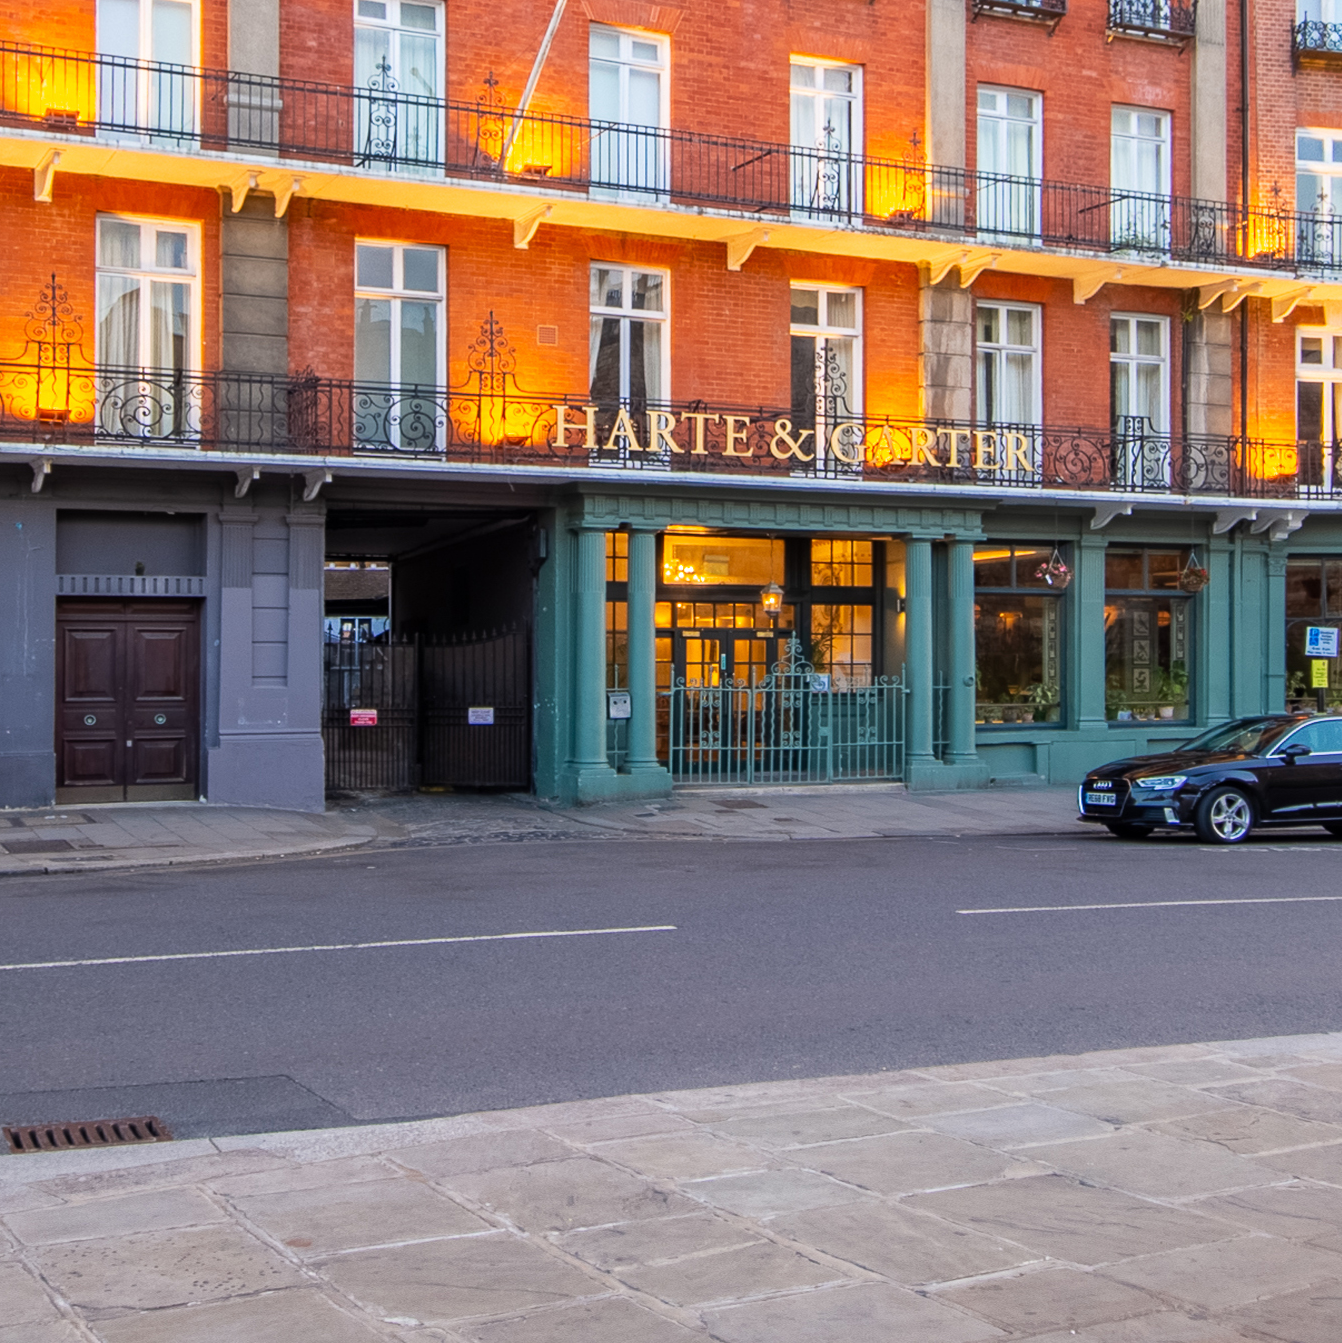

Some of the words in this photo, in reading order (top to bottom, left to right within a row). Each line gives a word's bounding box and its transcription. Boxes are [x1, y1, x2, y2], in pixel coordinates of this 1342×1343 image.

[551, 403, 755, 458] HARTE
[769, 418, 815, 463] &
[830, 422, 1035, 472] GARTER
